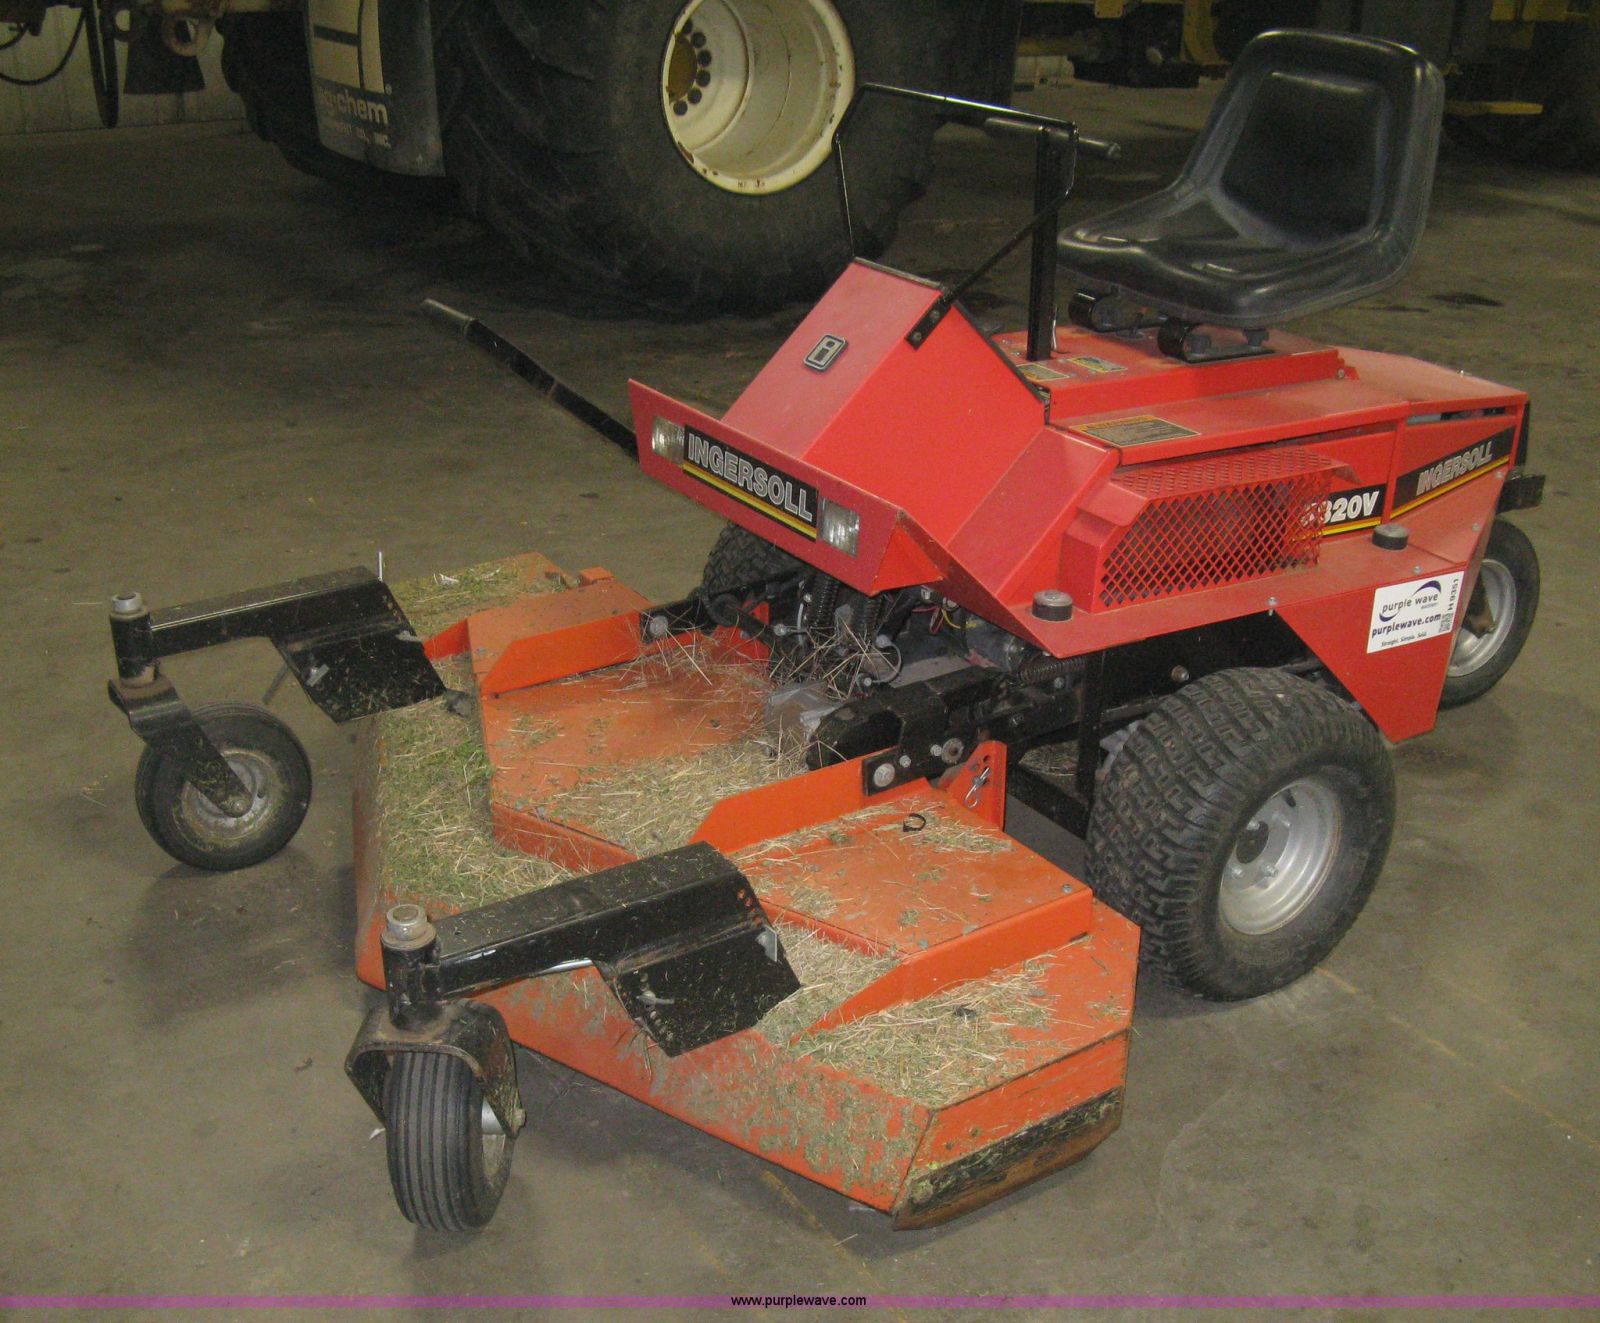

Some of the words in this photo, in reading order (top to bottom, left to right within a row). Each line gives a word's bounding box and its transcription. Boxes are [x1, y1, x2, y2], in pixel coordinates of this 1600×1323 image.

[688, 432, 813, 522] INGERSOLL
[1416, 441, 1492, 496] INGERSOLL
[1382, 598, 1412, 614] purple
[1415, 593, 1438, 605] wave
[1372, 613, 1441, 639] purplewave.com
